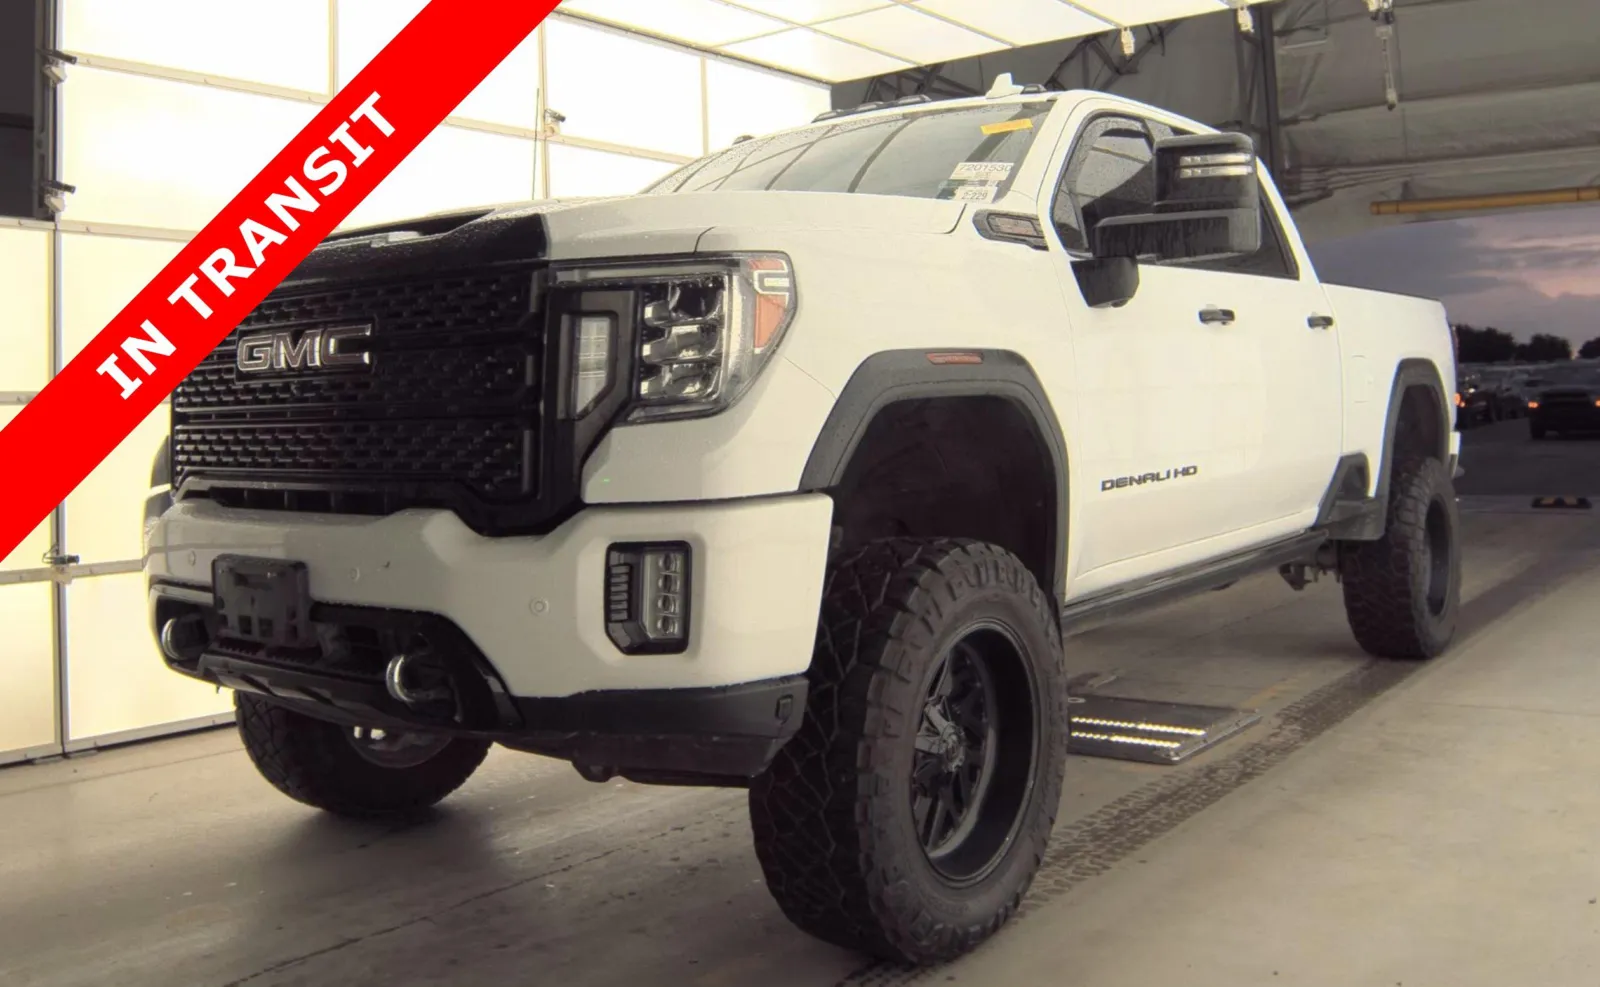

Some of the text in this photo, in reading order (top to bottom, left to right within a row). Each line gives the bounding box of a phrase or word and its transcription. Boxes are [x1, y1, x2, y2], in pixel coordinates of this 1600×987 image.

[237, 323, 371, 371] GMC
[1101, 465, 1197, 492] DENALI HD
